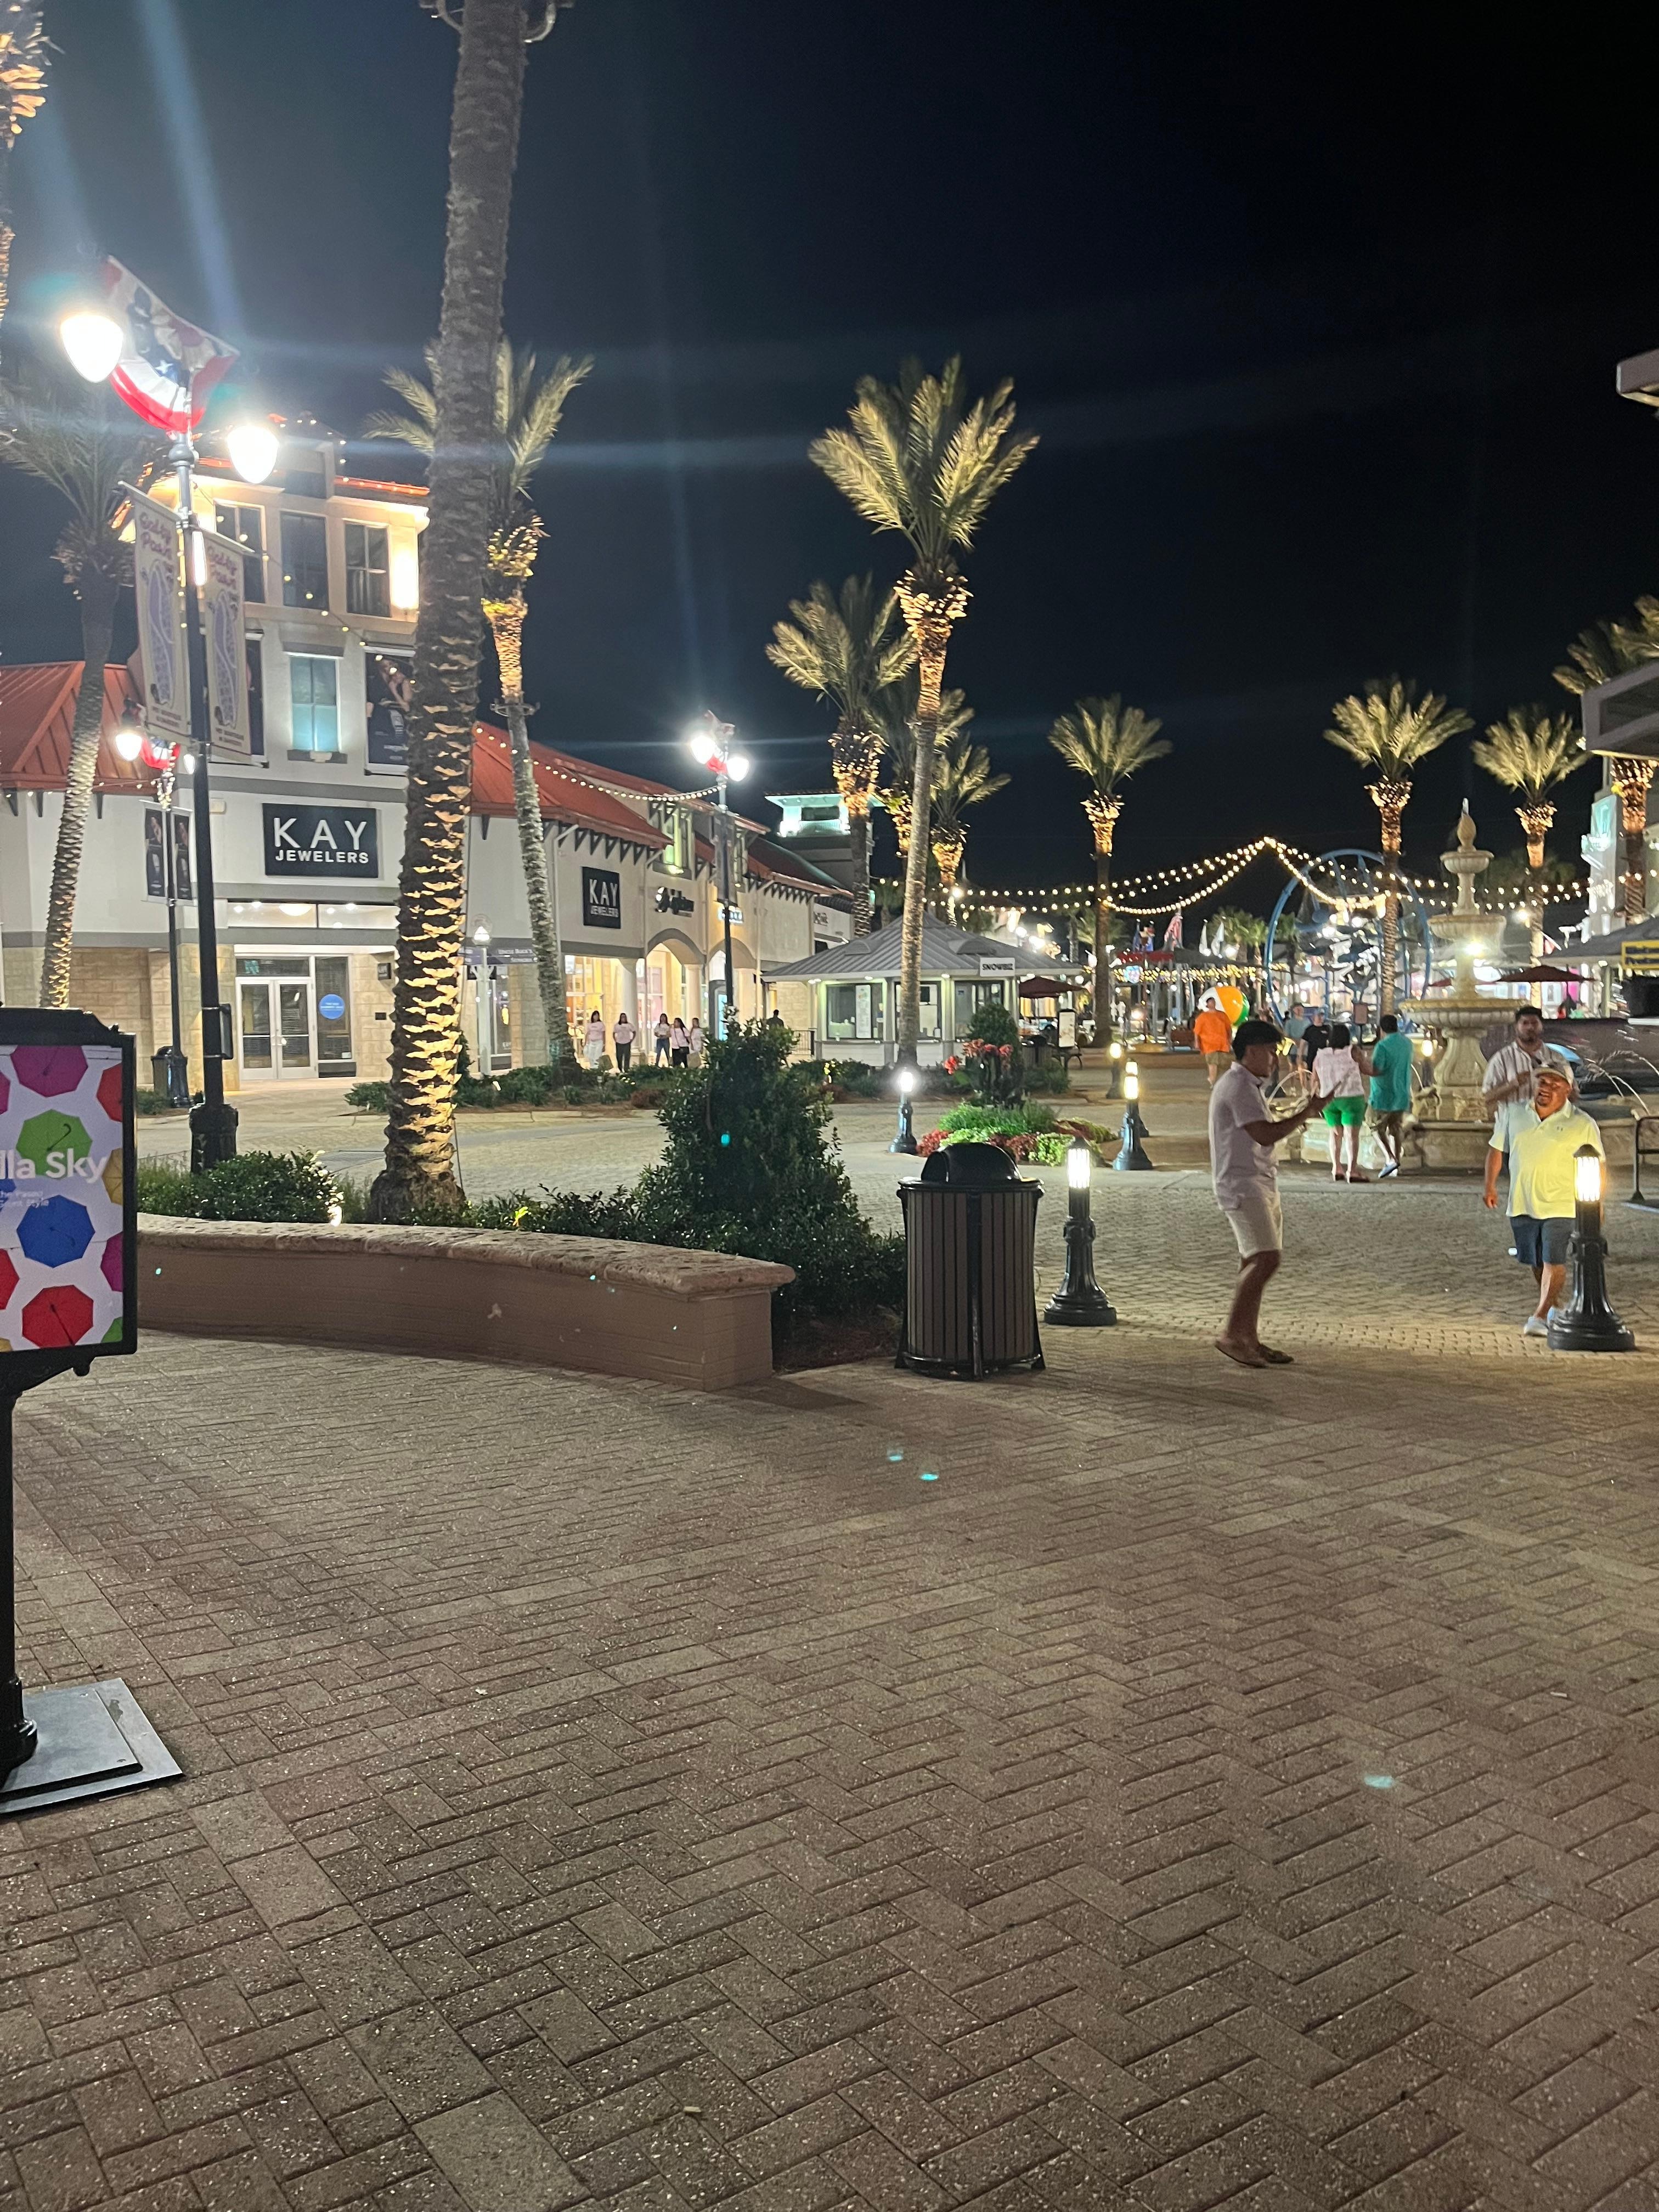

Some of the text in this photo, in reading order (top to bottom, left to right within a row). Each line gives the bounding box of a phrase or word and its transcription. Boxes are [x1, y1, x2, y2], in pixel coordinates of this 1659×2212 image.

[274, 817, 367, 850] KAY
[275, 849, 369, 864] JEWELERS
[589, 879, 618, 906] KAY
[46, 1148, 108, 1183] Sky
